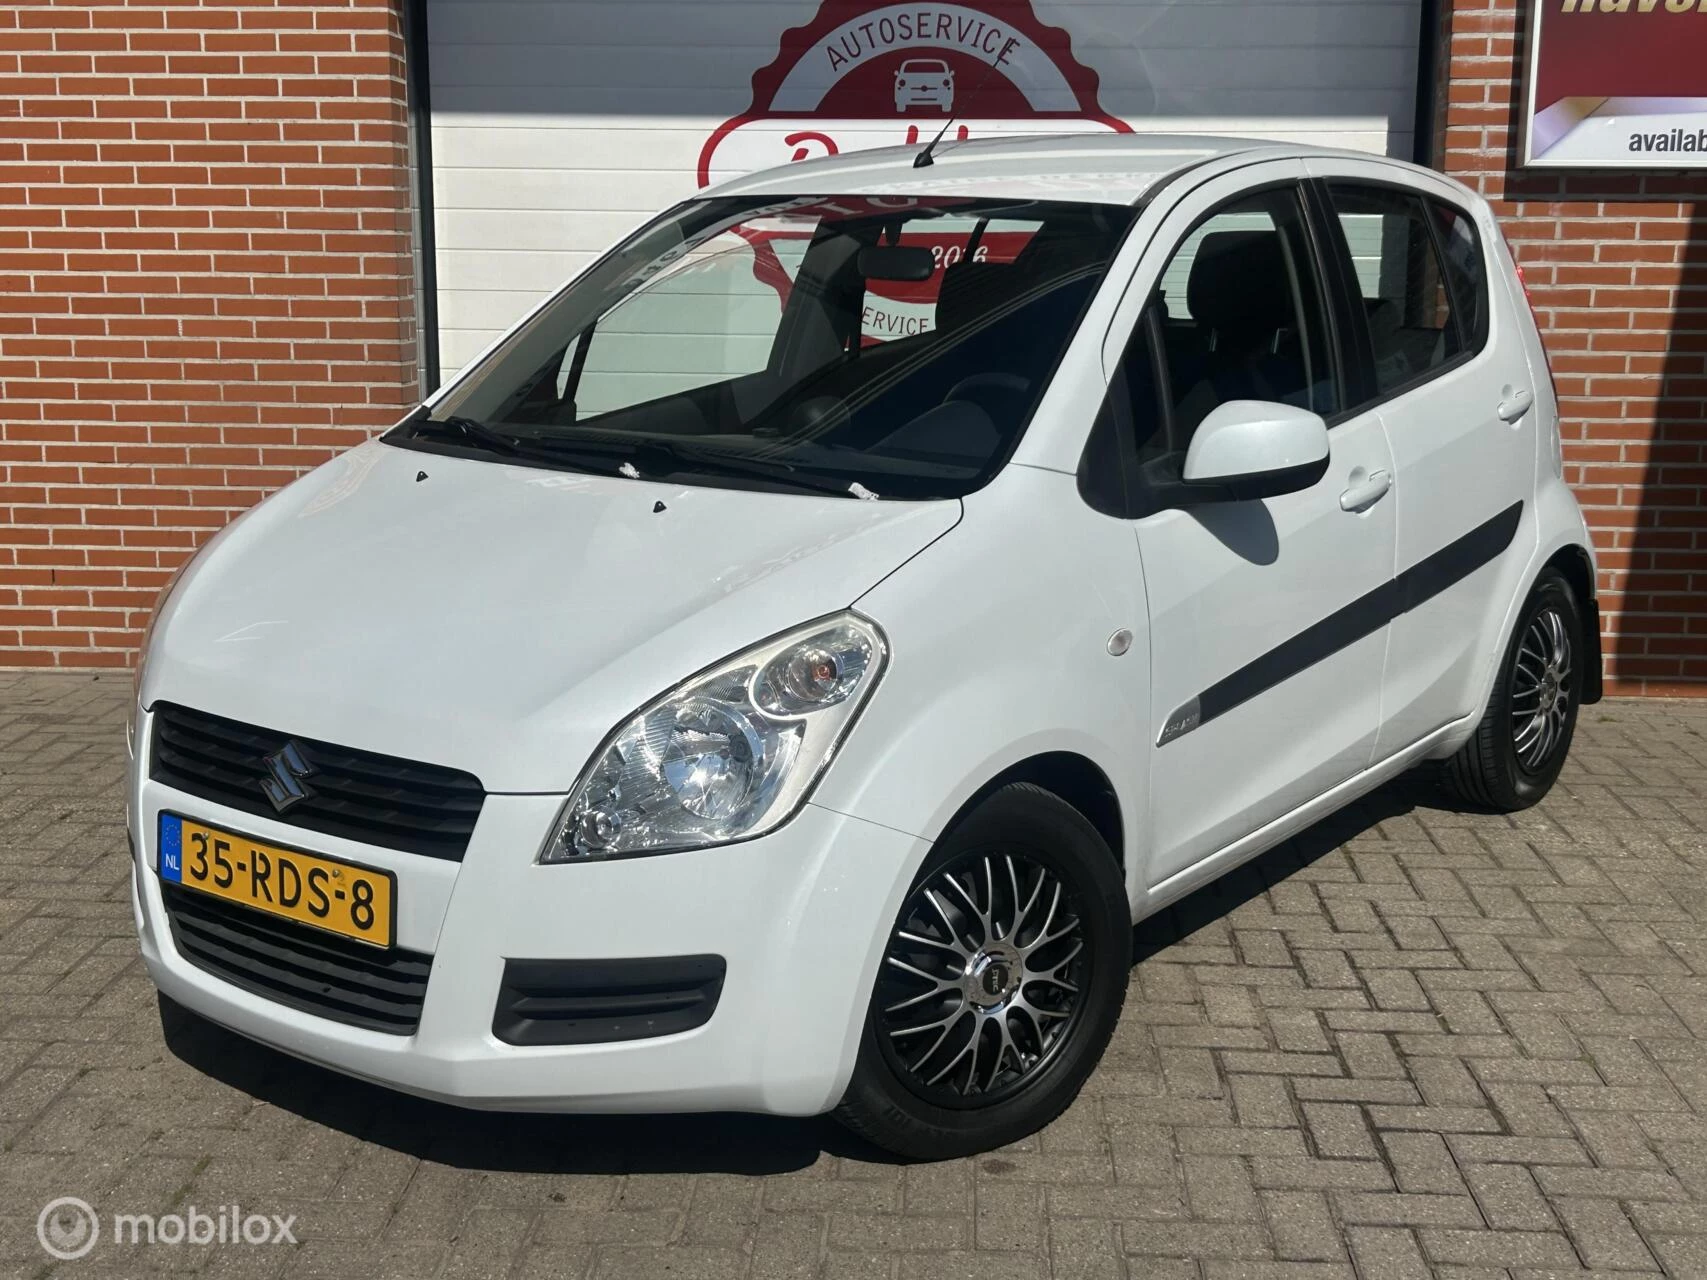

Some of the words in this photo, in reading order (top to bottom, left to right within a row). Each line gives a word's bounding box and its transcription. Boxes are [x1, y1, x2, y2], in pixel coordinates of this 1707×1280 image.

[825, 12, 1021, 71] AUTOSERVICE
[931, 245, 989, 269] 206
[862, 306, 929, 336] ERVICE
[165, 853, 180, 871] NL
[190, 832, 375, 931] 35-RDS-8
